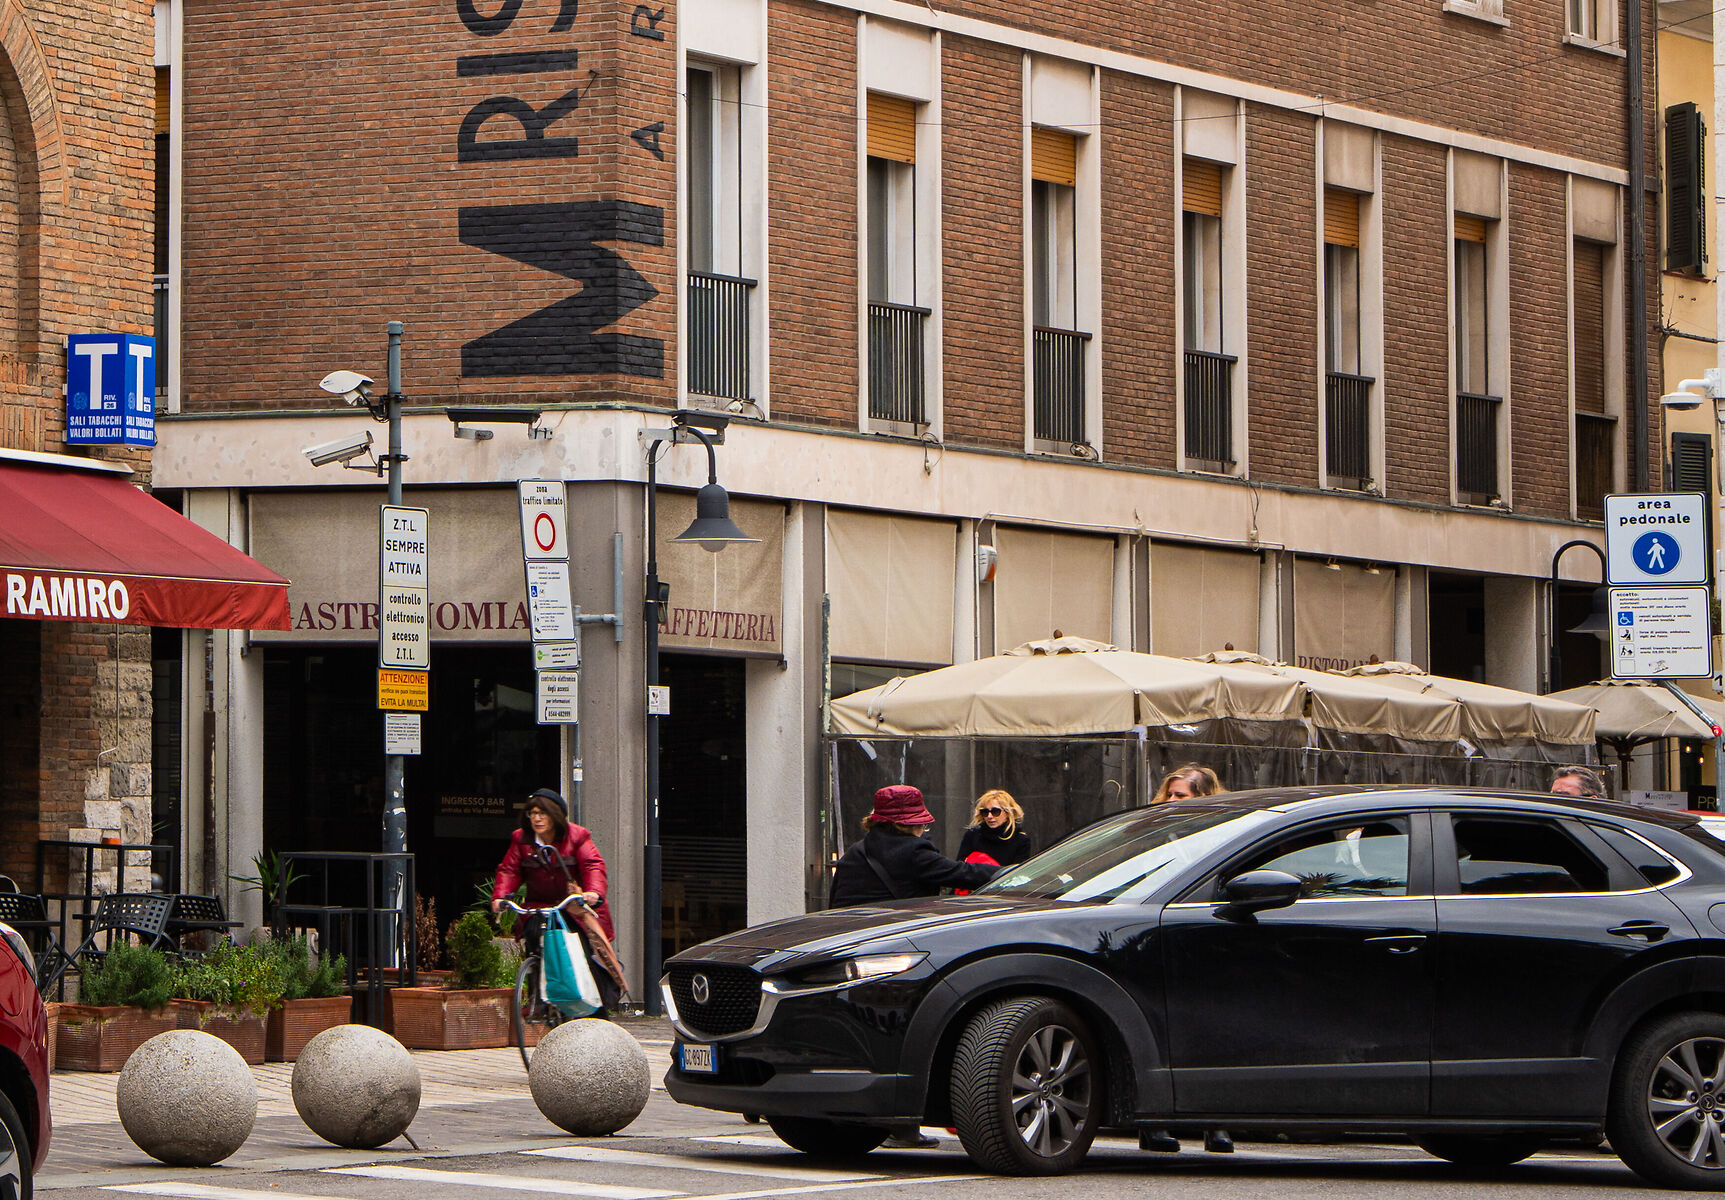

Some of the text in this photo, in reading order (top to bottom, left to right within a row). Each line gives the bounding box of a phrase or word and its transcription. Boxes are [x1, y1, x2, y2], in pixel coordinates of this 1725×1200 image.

[75, 343, 118, 409] T
[129, 343, 152, 411] T
[70, 415, 122, 426] SALI TABACCHI
[70, 428, 122, 438] VALORI BOLLATI
[523, 495, 563, 505] traffico limitato
[1637, 500, 1672, 510] area
[393, 518, 417, 532] Z.T.L.
[1619, 513, 1691, 527] pedonale
[385, 539, 425, 554] SEMPRE
[388, 561, 421, 575] ATTIVA
[6, 573, 130, 620] RAMIRO
[389, 593, 422, 605] controllo
[290, 601, 531, 631] ASTROMIA
[386, 610, 425, 624] elettronico
[658, 607, 776, 642] AFFETTERIA
[392, 632, 419, 642] accesso
[396, 647, 415, 660] Z.T.L.
[381, 698, 396, 706] EVITA
[441, 796, 505, 806] INGRESSO BAR
